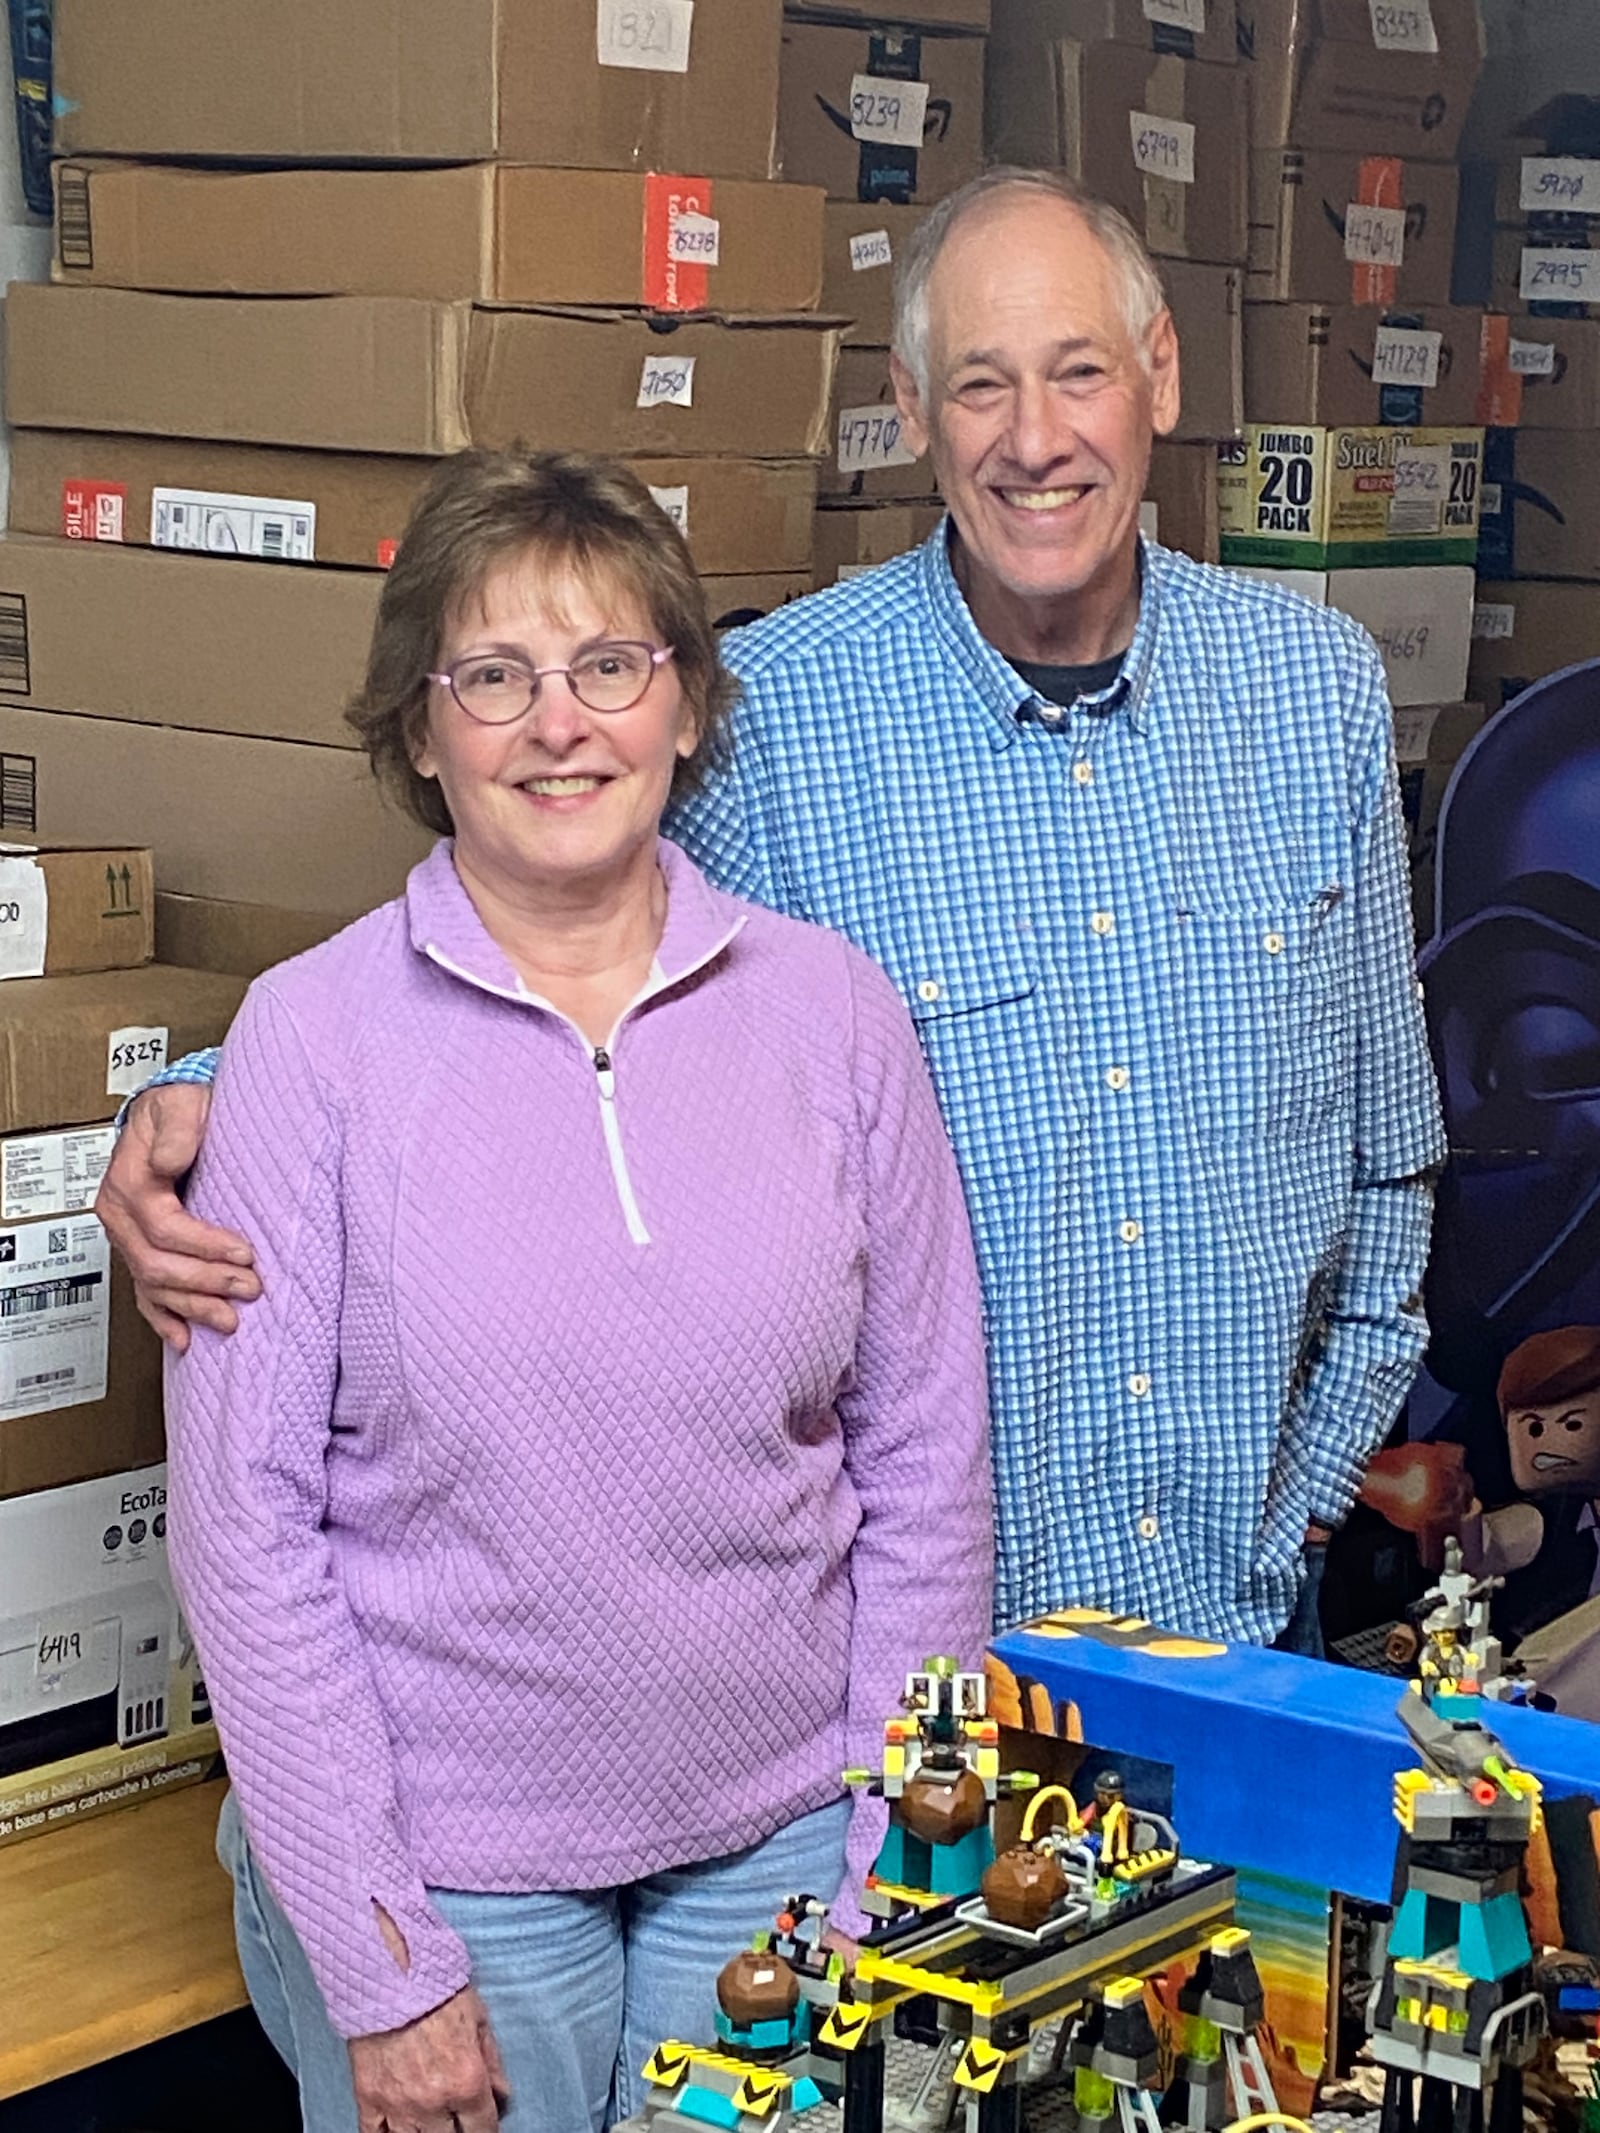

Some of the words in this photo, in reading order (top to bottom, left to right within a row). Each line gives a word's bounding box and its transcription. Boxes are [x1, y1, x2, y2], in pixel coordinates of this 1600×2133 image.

[852, 93, 900, 131] 8239
[1137, 129, 1179, 168] 6799
[1531, 261, 1588, 289] 2995
[1259, 433, 1313, 455] JUMBO
[1258, 455, 1313, 506] 20
[1448, 461, 1477, 503] 20
[1257, 506, 1310, 532] PACK
[1444, 504, 1474, 526] PACK
[121, 1486, 167, 1514] EcoTa
[39, 1632, 81, 1663] 6419
[15, 1811, 46, 1830] base
[48, 1801, 77, 1820] sans
[79, 1781, 140, 1811] cartouche
